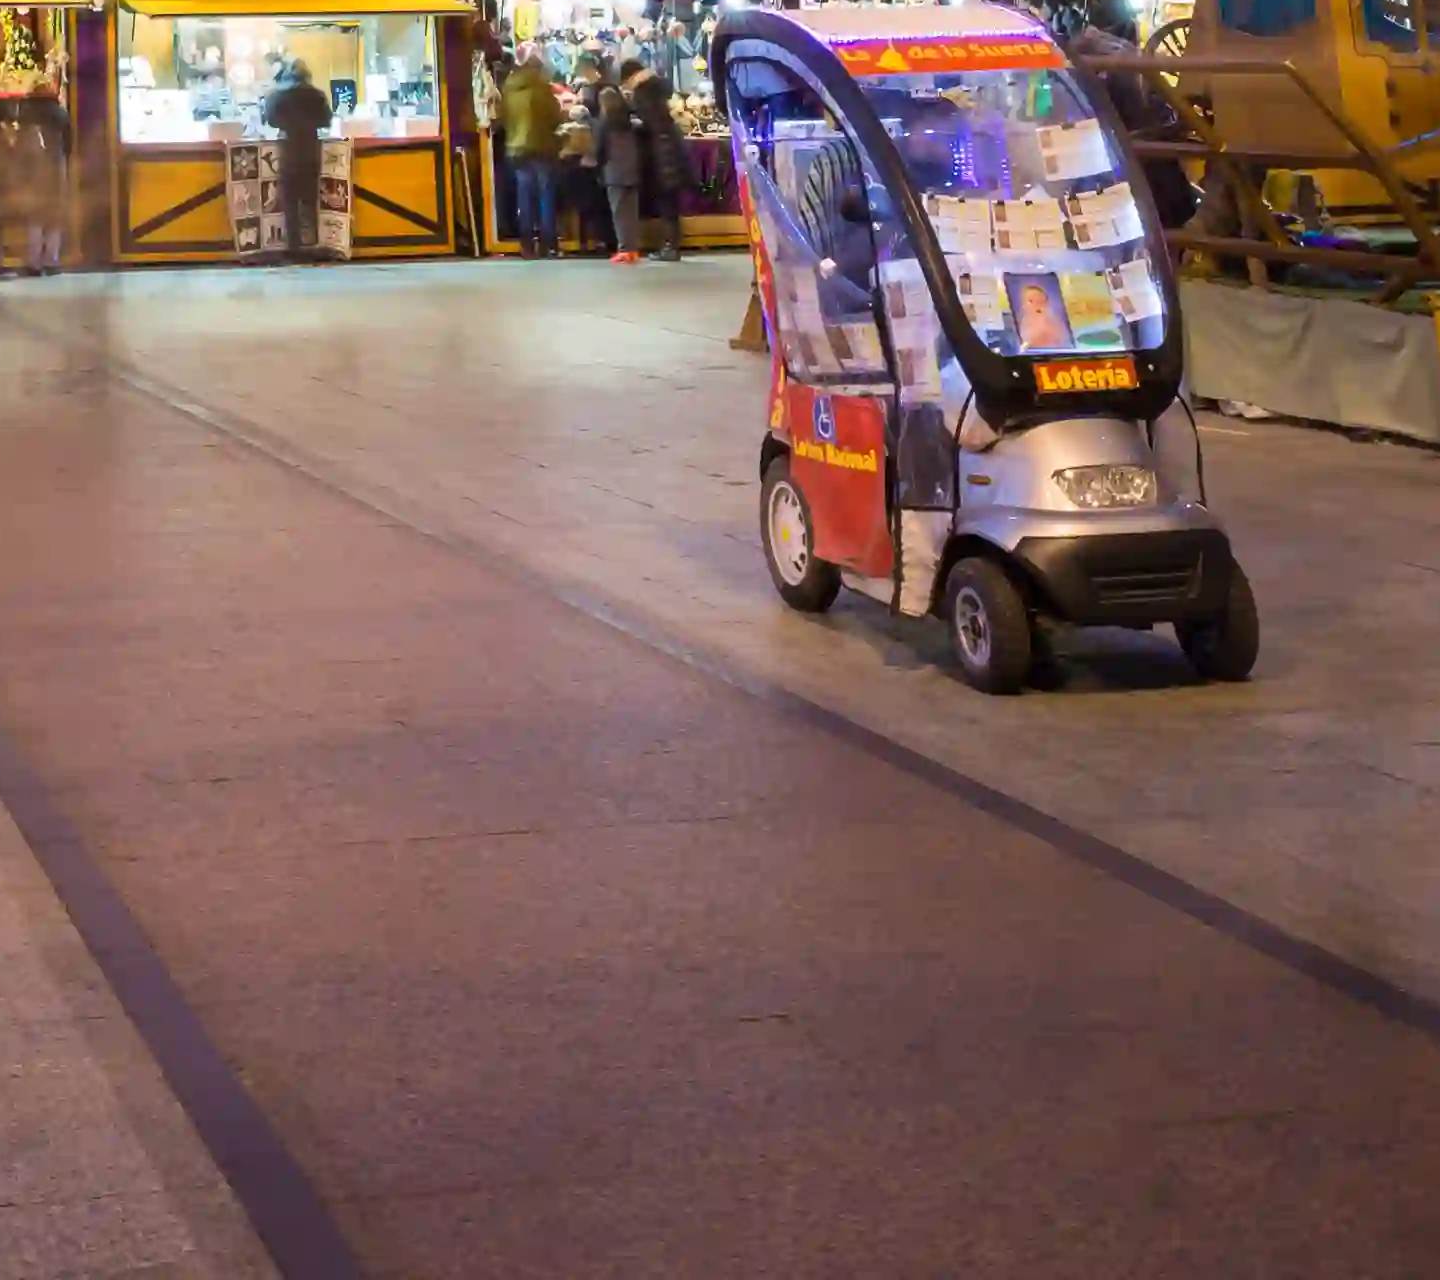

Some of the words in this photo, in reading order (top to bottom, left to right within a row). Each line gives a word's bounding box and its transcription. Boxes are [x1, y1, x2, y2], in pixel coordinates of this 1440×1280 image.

[907, 45, 940, 60] de
[940, 43, 968, 59] la
[969, 41, 1051, 59] Suerte
[1039, 361, 1131, 391] Lotería
